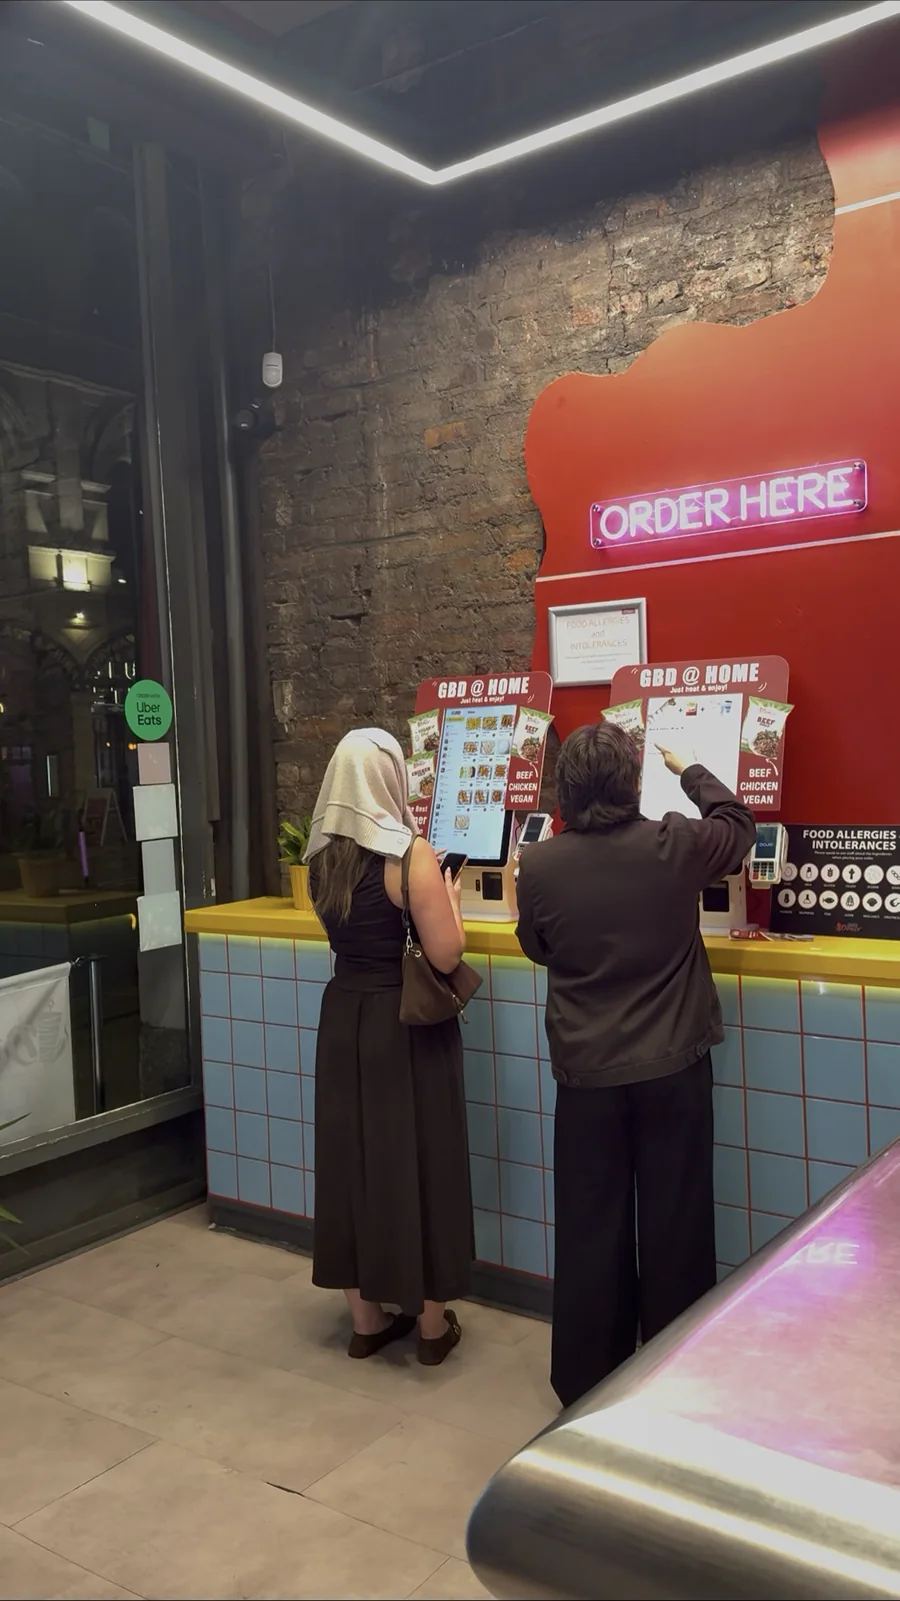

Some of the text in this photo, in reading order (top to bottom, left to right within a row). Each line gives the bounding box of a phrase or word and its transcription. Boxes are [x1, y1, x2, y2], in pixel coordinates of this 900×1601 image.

[600, 467, 853, 540] ORDER HERE
[566, 620, 587, 629] FOOD
[640, 663, 760, 688] GBD @ HOME
[438, 677, 530, 699] GBD @ HOME
[685, 685, 700, 693] heat
[701, 684, 707, 692] &
[708, 684, 728, 693] enjoy!
[489, 696, 505, 704] enjoy!
[136, 701, 161, 713] Uber
[137, 714, 162, 726] Eats
[515, 770, 533, 780] BEEF
[749, 768, 772, 778] BEEF
[508, 782, 538, 792] CHICKEN
[740, 781, 778, 791] CHICKEN
[510, 794, 533, 803] VEGAN
[743, 795, 774, 805] VEGAN
[803, 829, 897, 840] FOOD ALLERGIES
[812, 840, 896, 851] INTOLERANCES
